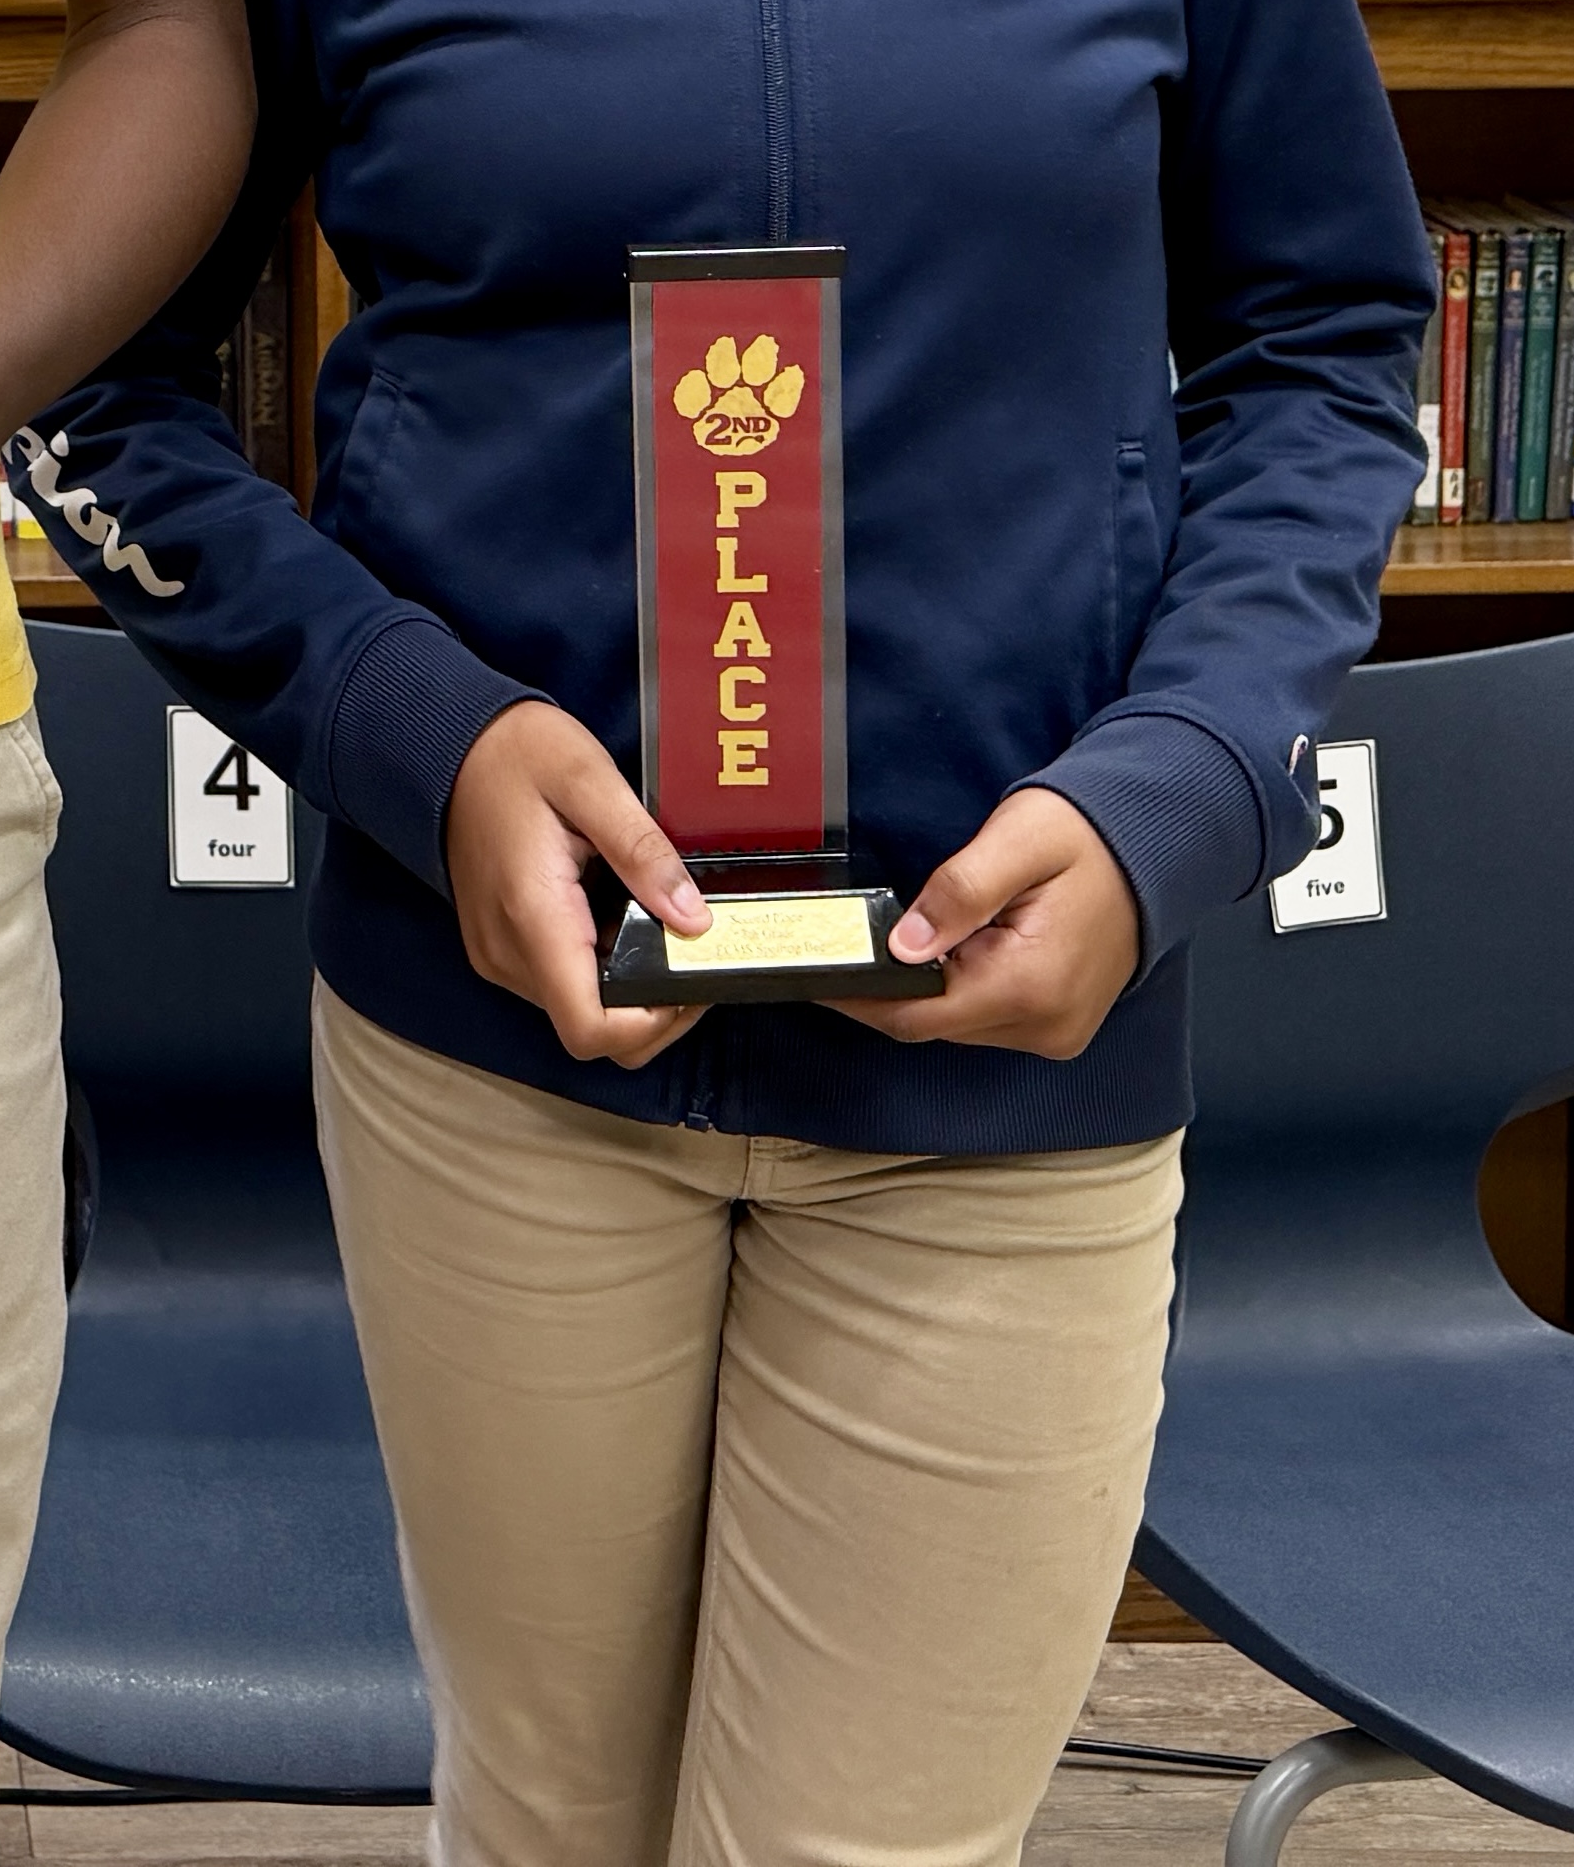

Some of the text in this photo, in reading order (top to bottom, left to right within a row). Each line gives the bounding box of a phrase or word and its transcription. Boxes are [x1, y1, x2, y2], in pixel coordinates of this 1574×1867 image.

[705, 413, 771, 445] 2ND
[714, 470, 771, 788] PLACE
[203, 741, 261, 812] 4
[208, 839, 256, 858] four
[1306, 879, 1345, 898] five
